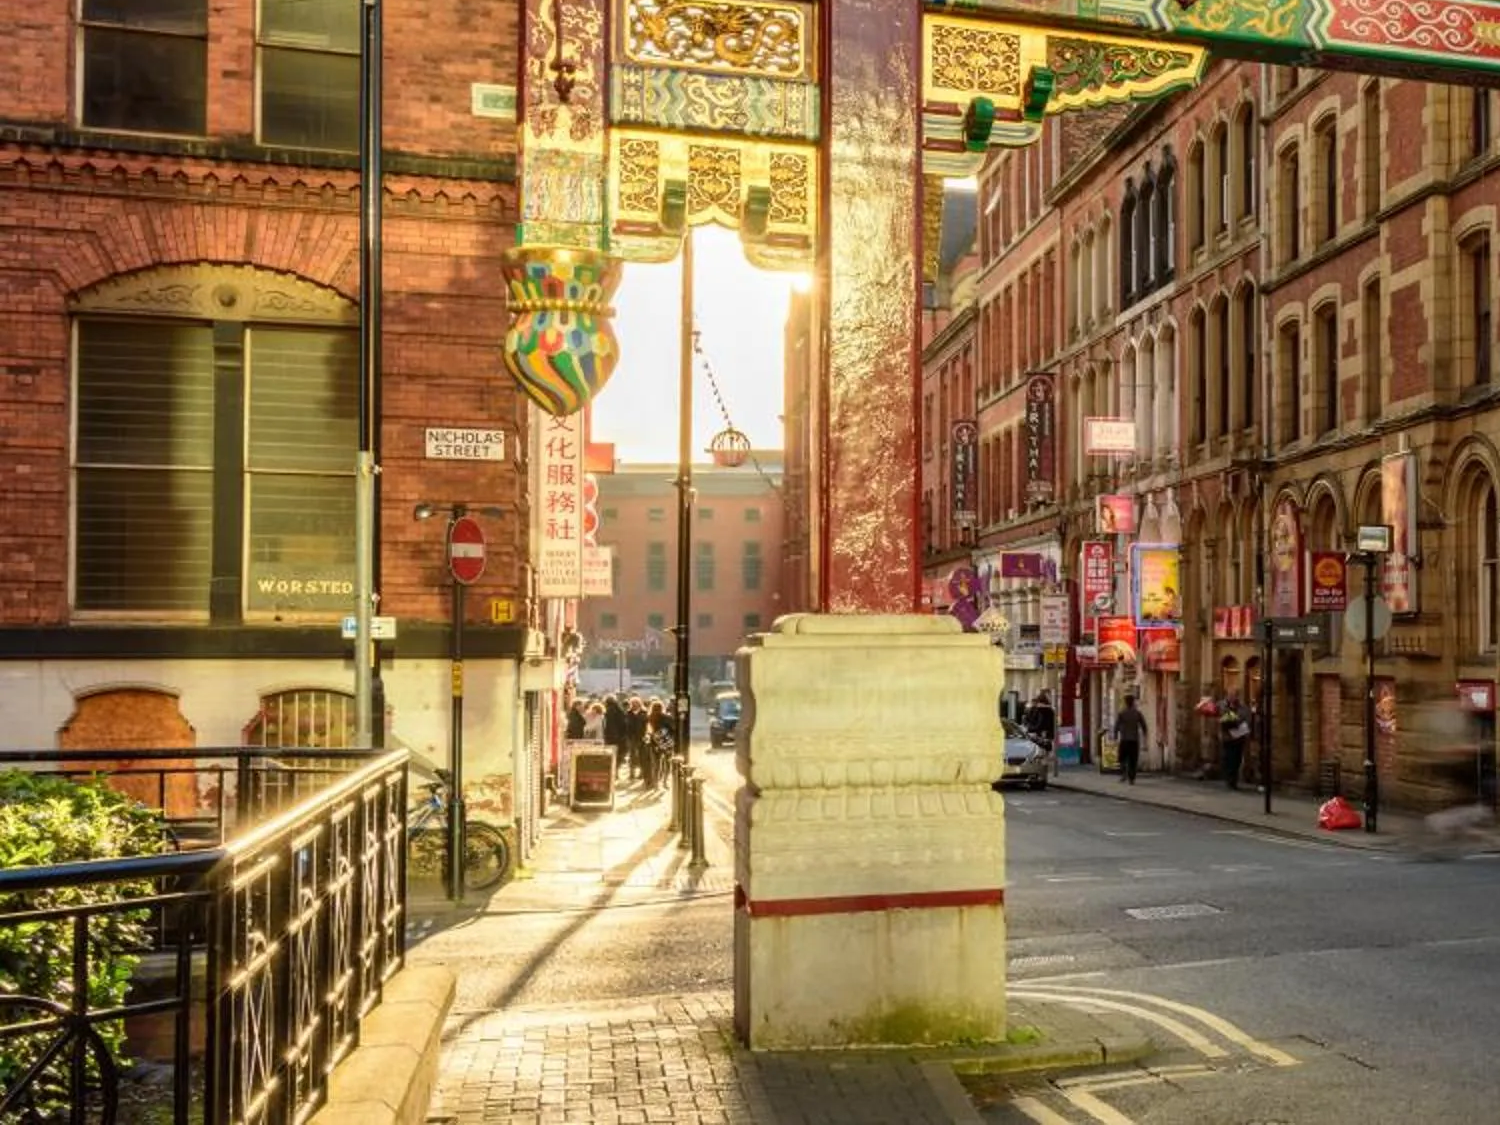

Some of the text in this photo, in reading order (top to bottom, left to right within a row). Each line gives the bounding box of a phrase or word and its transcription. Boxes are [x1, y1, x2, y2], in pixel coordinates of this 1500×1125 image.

[427, 430, 504, 444] NICHOLAS
[434, 444, 491, 458] STREET
[257, 578, 353, 594] WORSTED
[494, 602, 511, 620] H
